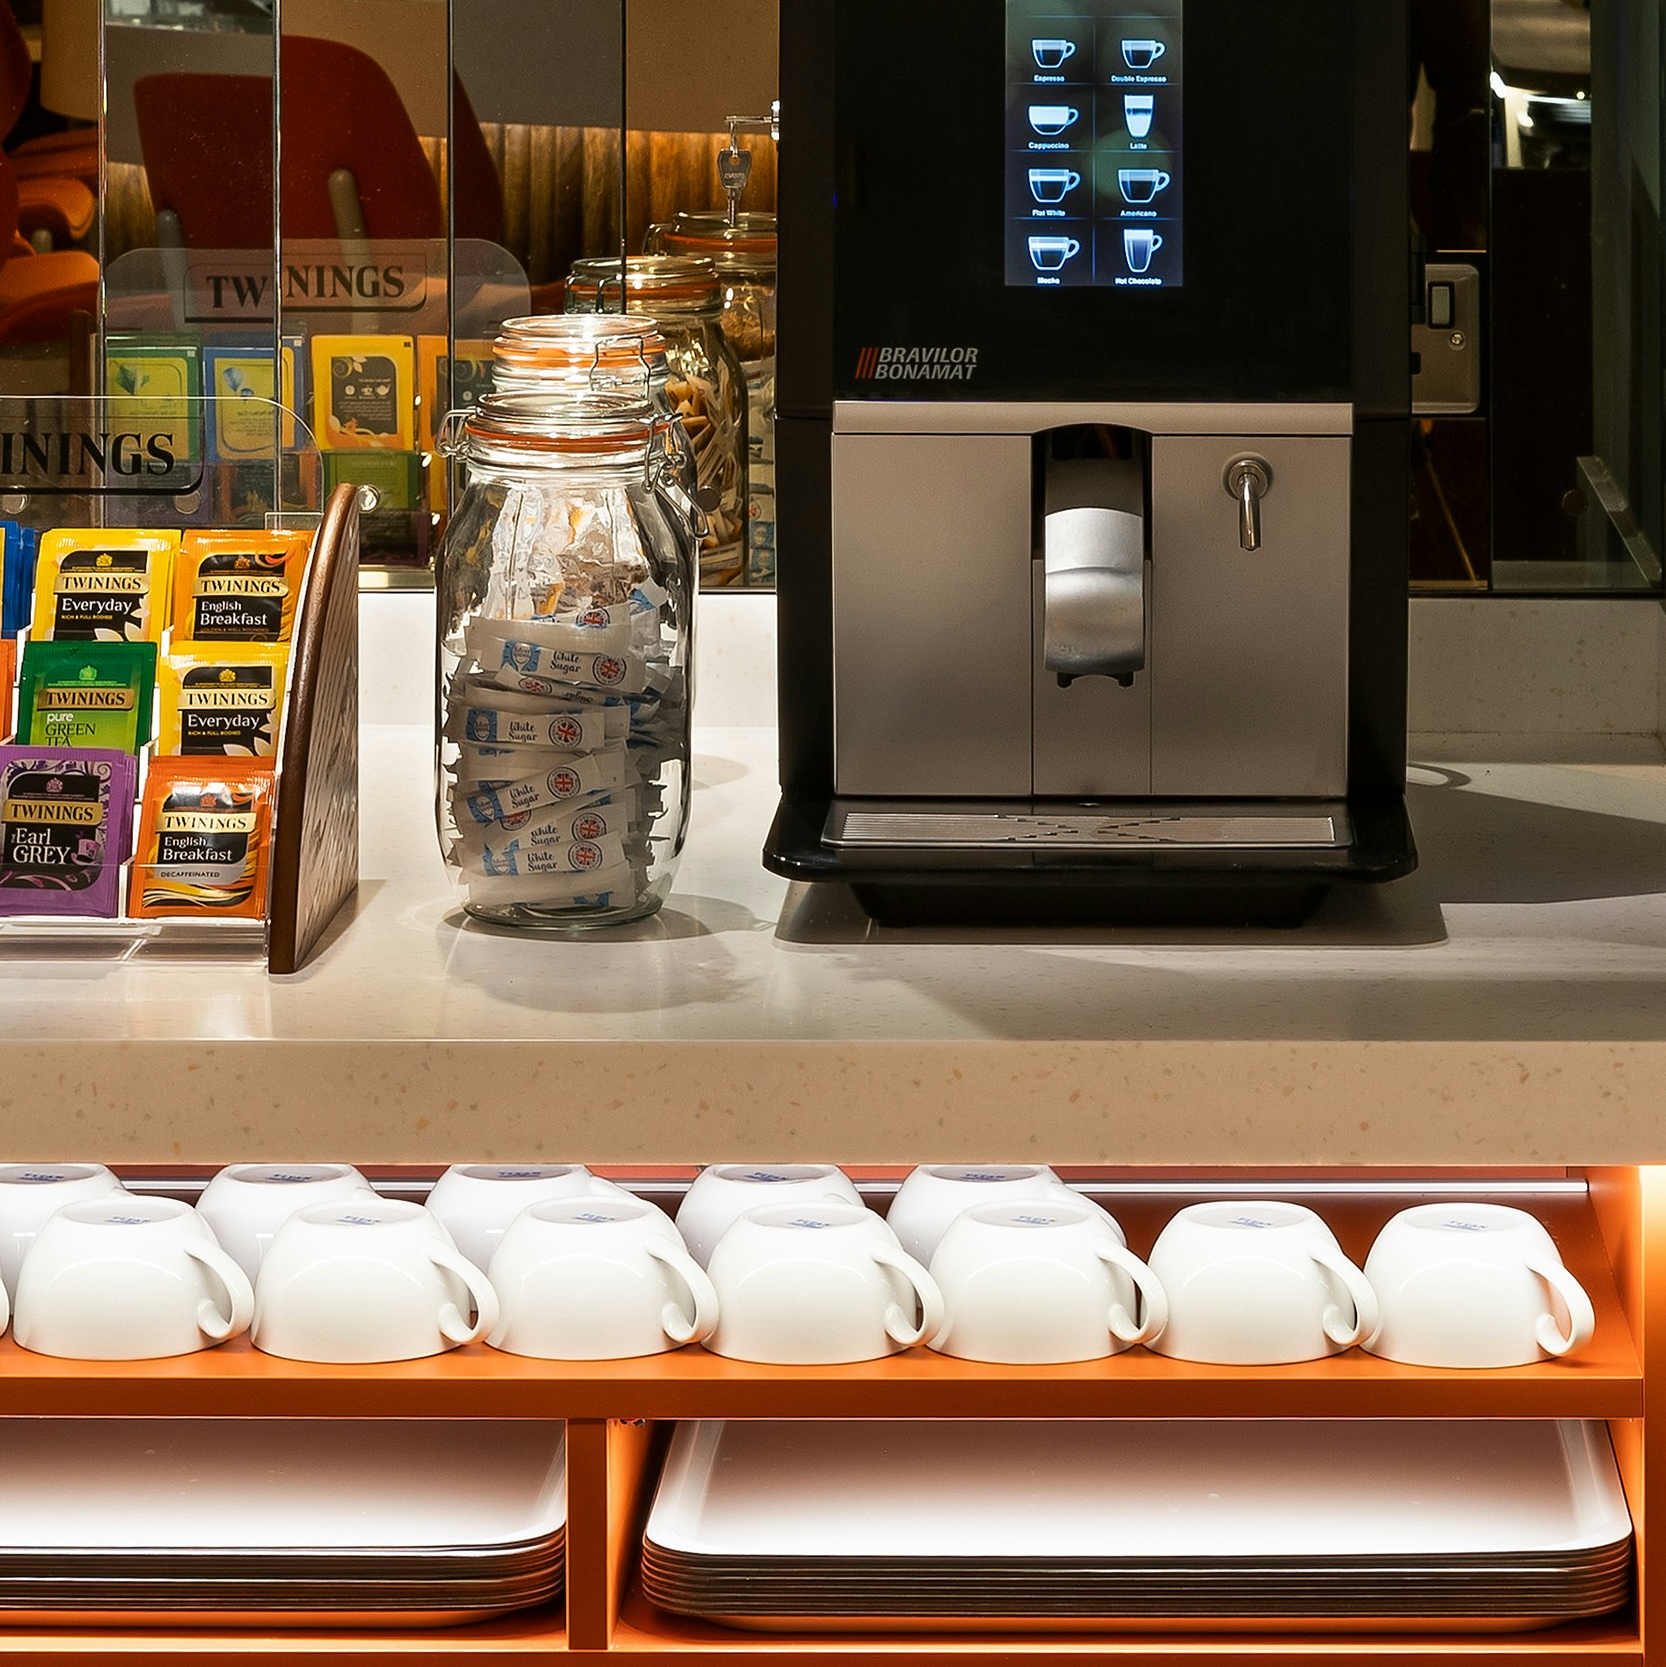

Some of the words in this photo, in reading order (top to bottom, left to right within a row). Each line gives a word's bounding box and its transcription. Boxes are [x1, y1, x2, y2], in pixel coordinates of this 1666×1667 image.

[1034, 74, 1065, 83] Espresso
[1028, 142, 1069, 150] Cappuccino
[206, 265, 406, 309] TWNINGS
[878, 346, 979, 363] BRAVILOR
[874, 363, 978, 380] BONAMAT
[62, 576, 142, 590] TWININGS
[201, 578, 281, 592] TWININGS
[62, 598, 133, 614] Everyday
[201, 600, 242, 613] English
[200, 613, 268, 626] Breakfast
[549, 660, 581, 675] Sugar
[46, 692, 125, 706] TWININGS
[187, 693, 268, 706] TWININGS
[46, 713, 74, 724] pure
[187, 714, 260, 730] Everyday
[45, 724, 96, 736] GREEN
[45, 736, 73, 747] TEA
[508, 731, 537, 745] Sugar
[511, 794, 540, 810] Sugar
[11, 804, 94, 821] TWININGS
[164, 816, 247, 829] TWININGS
[15, 828, 51, 845] Earl
[164, 836, 207, 848] English
[531, 835, 561, 847] Sugar
[13, 845, 72, 865] GREY
[163, 848, 233, 862] Breakfast
[528, 861, 557, 873] Sugar
